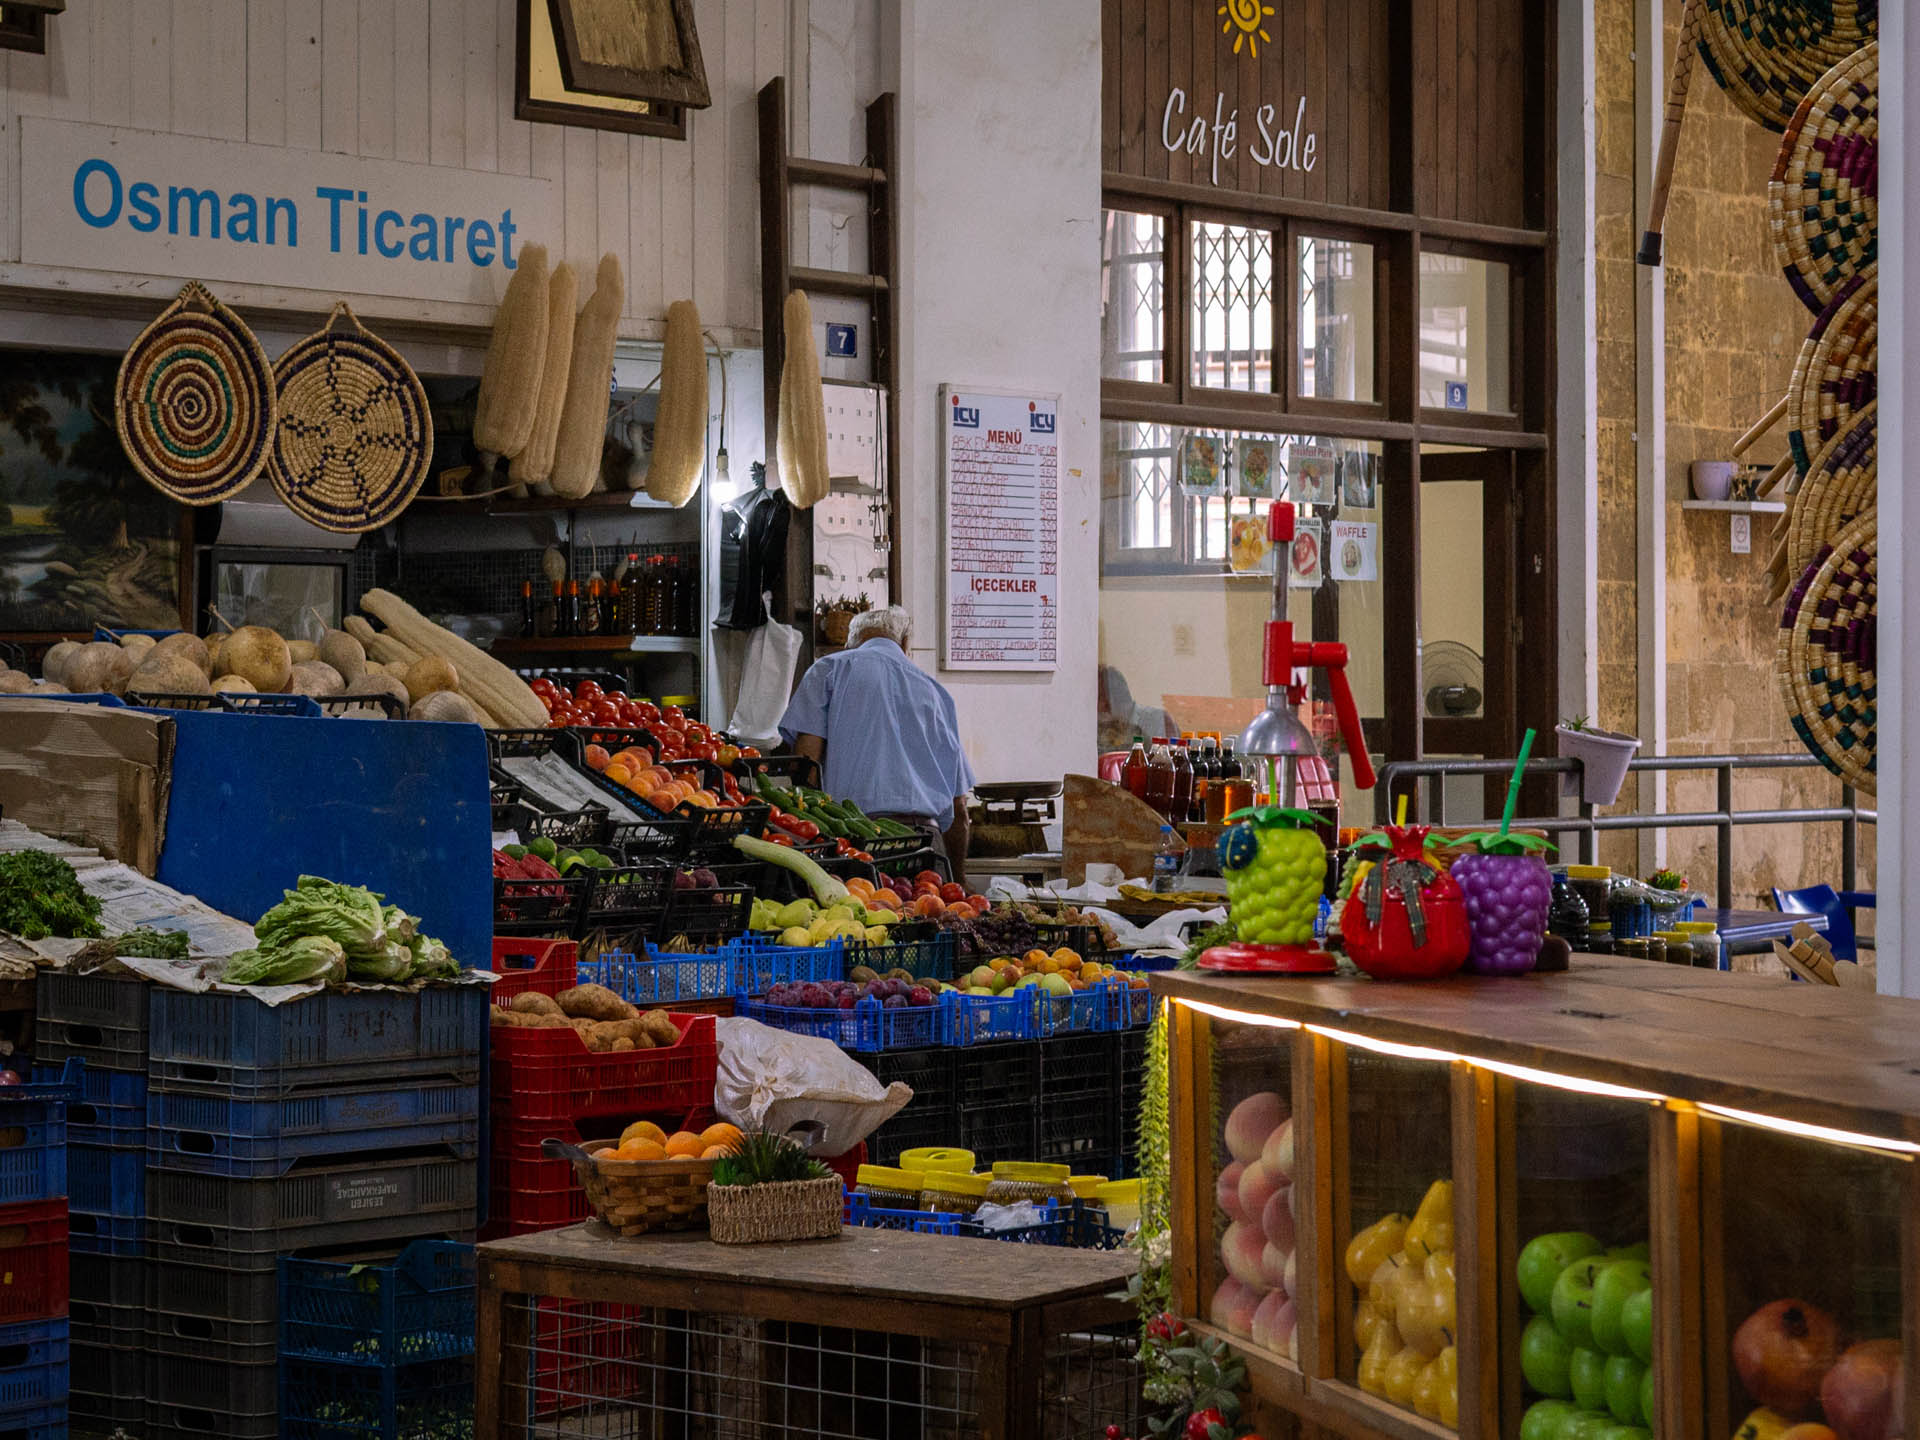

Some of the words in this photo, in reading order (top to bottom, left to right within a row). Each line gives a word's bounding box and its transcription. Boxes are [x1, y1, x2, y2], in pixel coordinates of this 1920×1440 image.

[1162, 87, 1238, 185] Café
[1249, 96, 1317, 172] Sole
[72, 158, 299, 248] Osman
[316, 187, 517, 270] Ticaret
[837, 331, 848, 349] 7
[1453, 387, 1461, 402] 9
[987, 429, 1022, 445] MENÜ
[1336, 526, 1367, 538] WAFFLE
[971, 573, 1037, 595] İÇECEKLER
